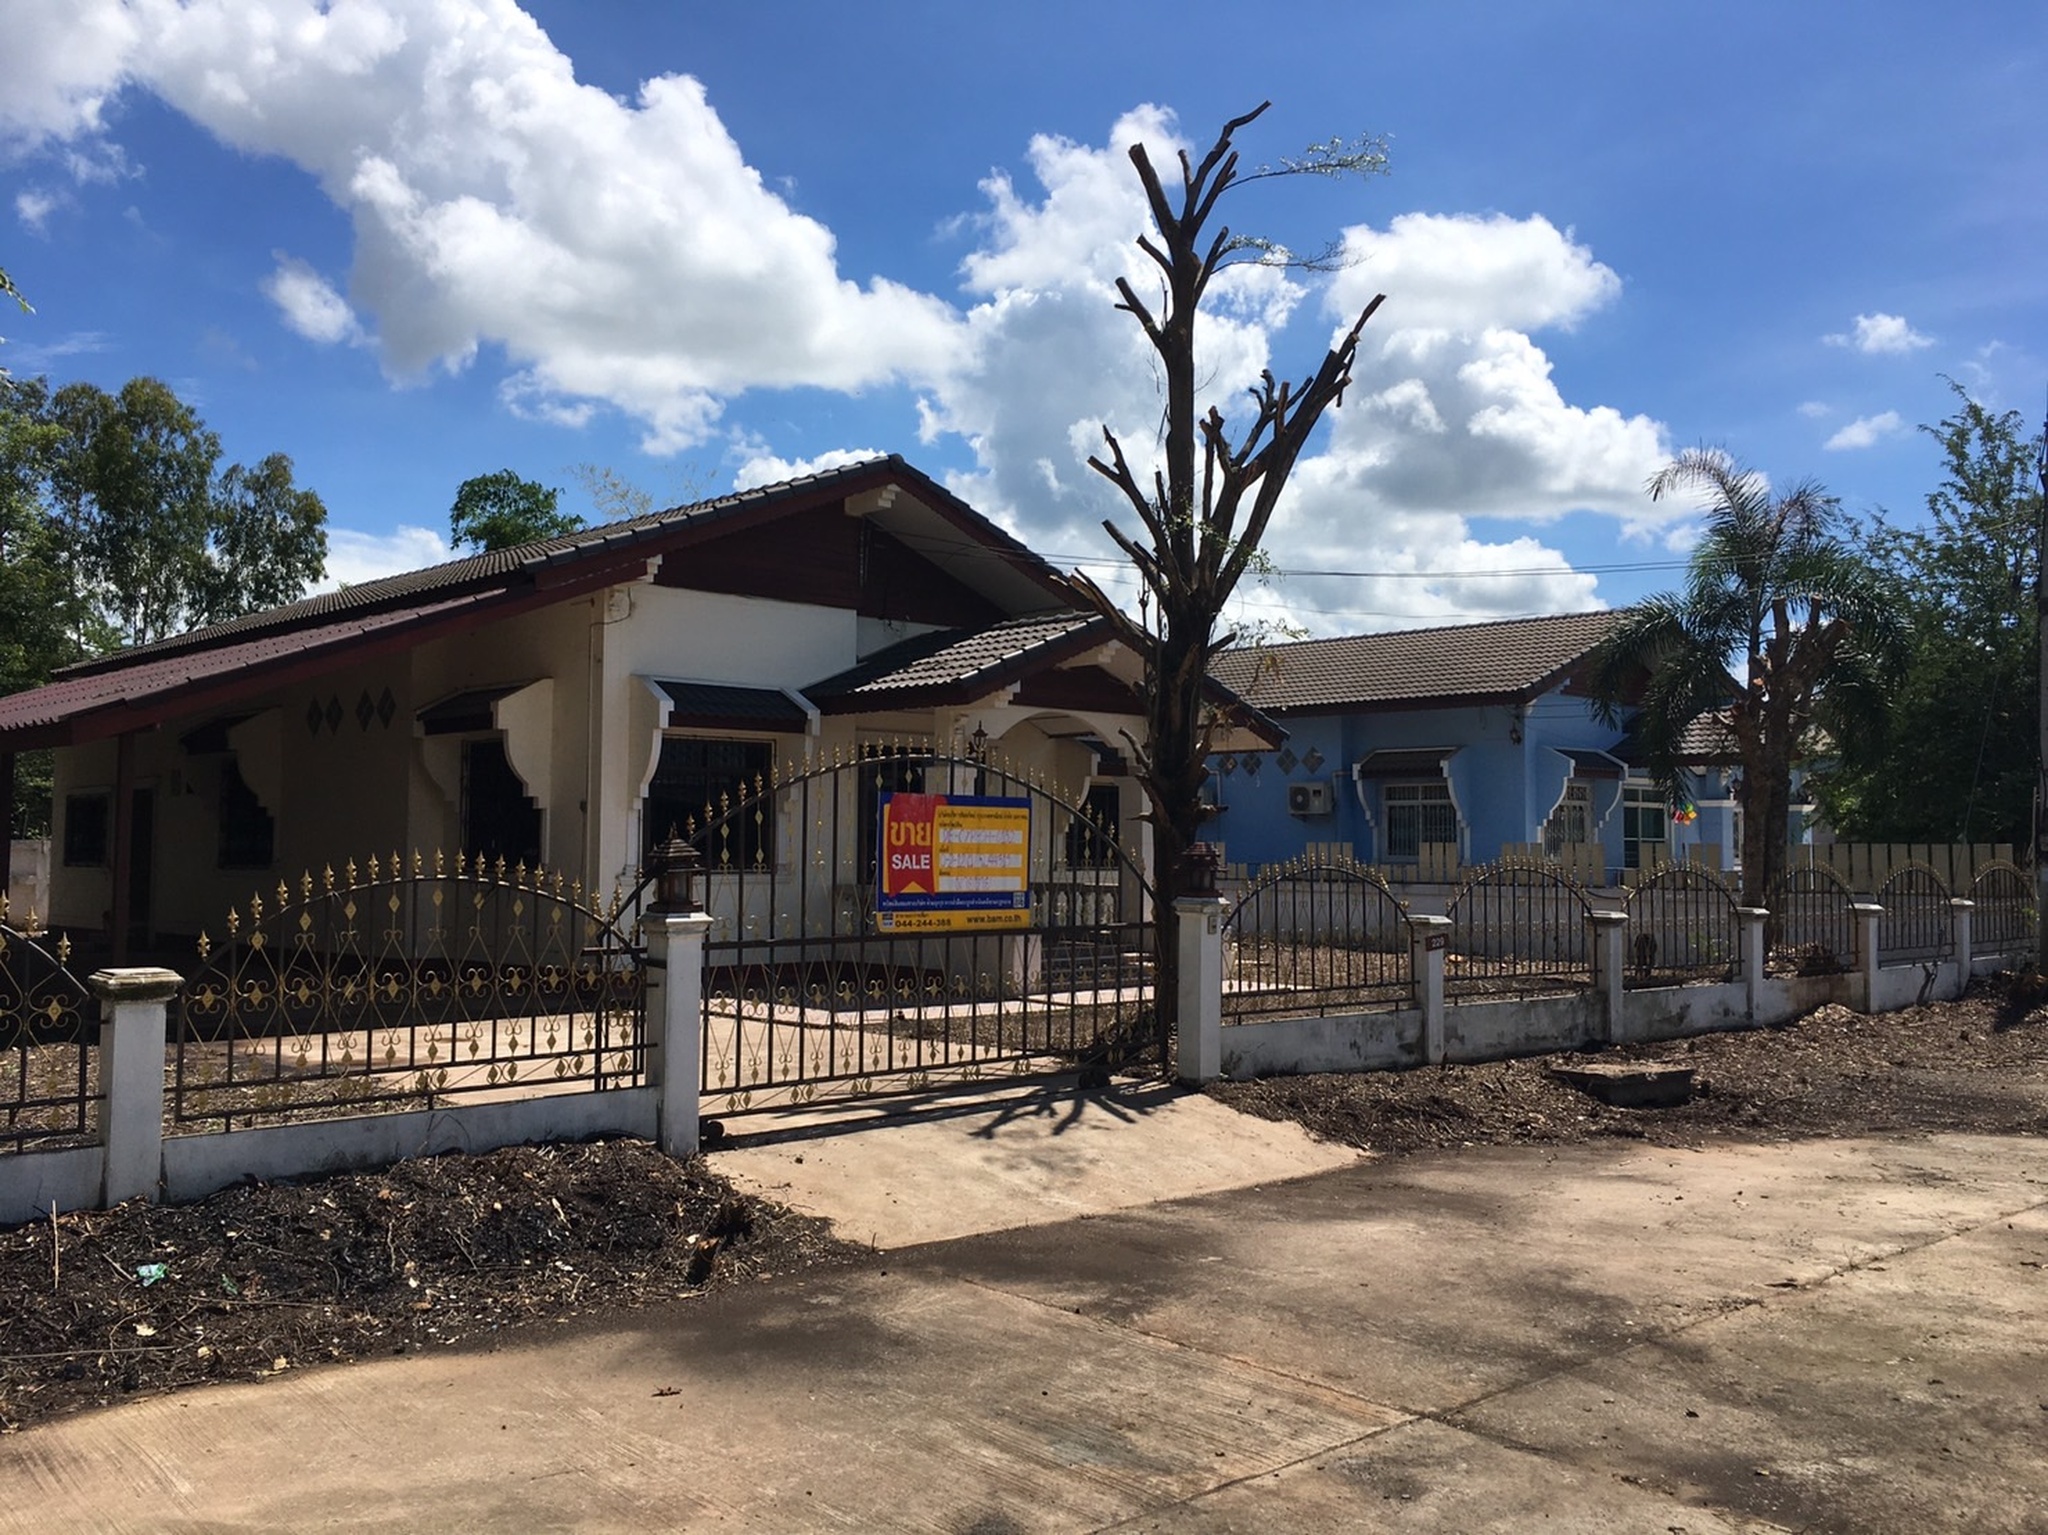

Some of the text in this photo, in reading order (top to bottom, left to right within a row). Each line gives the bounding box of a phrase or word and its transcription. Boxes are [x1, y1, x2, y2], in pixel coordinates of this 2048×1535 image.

[890, 821, 932, 847] ขาย
[892, 854, 931, 870] SALE
[966, 914, 1022, 924] www.bam.co.th
